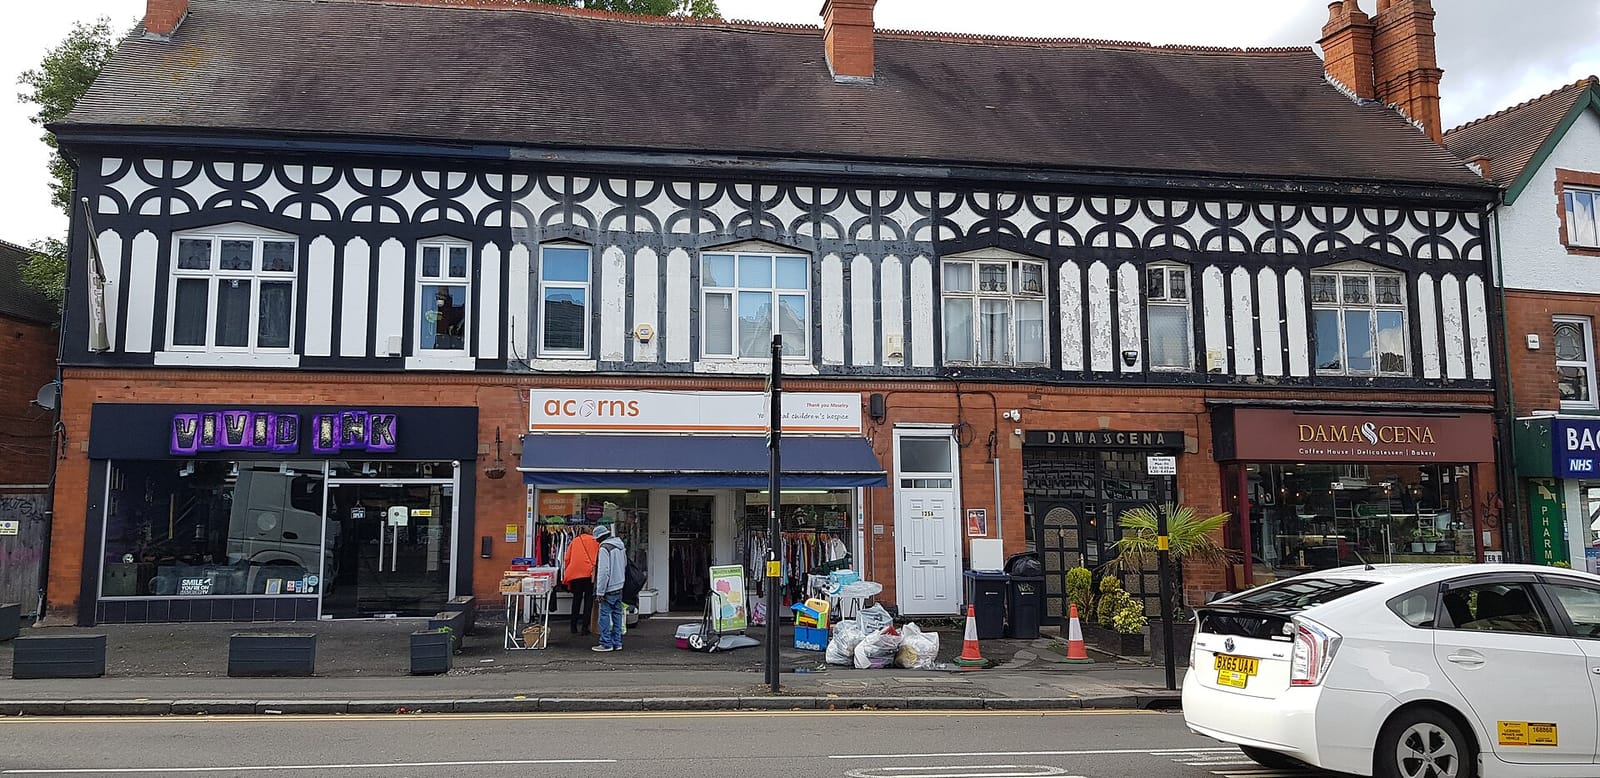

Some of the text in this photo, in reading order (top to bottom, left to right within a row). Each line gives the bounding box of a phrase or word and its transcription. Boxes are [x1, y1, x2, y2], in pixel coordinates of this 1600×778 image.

[544, 399, 640, 417] acorns
[791, 412, 825, 420] children's
[826, 412, 849, 421] hospice
[172, 412, 397, 450] VIVID INK
[1047, 431, 1165, 445] DAMASCENA
[1297, 421, 1436, 446] DAMASCENA
[1298, 447, 1437, 457] Coffee House Delicatessen Bakery
[1569, 458, 1593, 471] NHS
[1216, 655, 1254, 674] BX65 UAA
